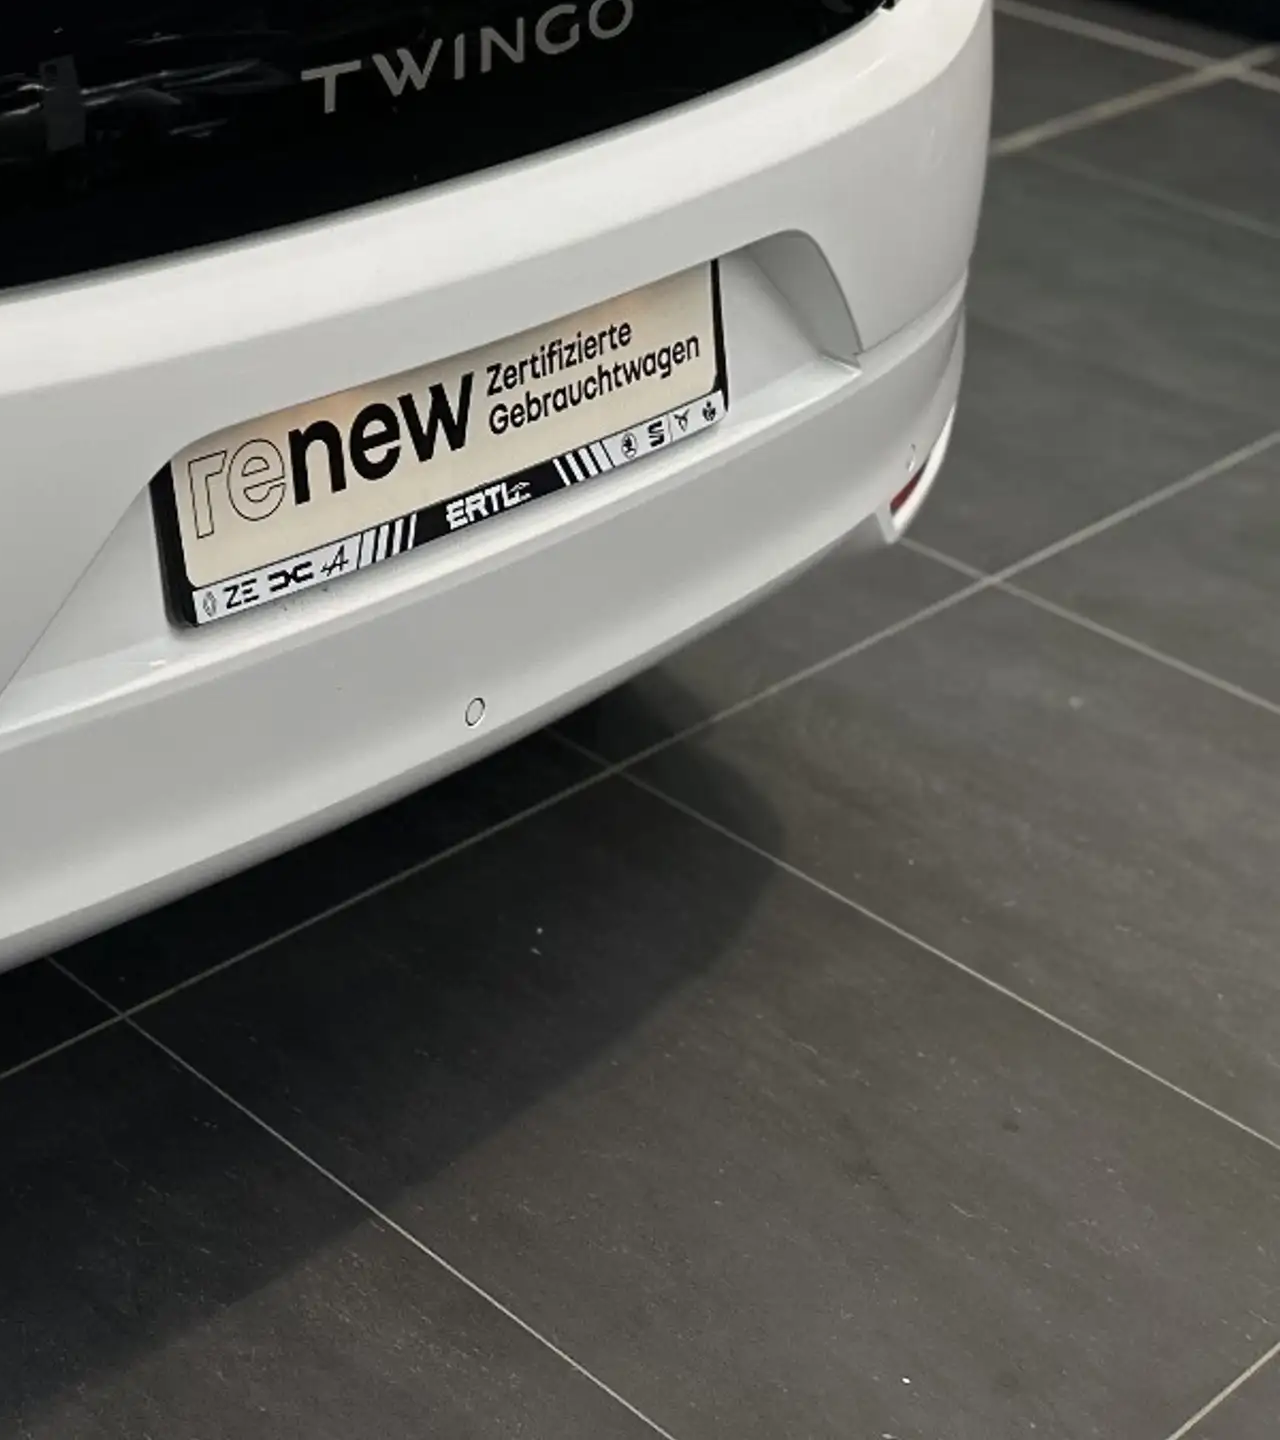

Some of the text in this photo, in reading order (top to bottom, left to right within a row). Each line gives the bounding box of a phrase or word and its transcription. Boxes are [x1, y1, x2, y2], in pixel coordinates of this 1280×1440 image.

[486, 321, 633, 397] Zertifizierte
[489, 335, 701, 435] Gebrauchtwagen
[188, 372, 475, 540] renew
